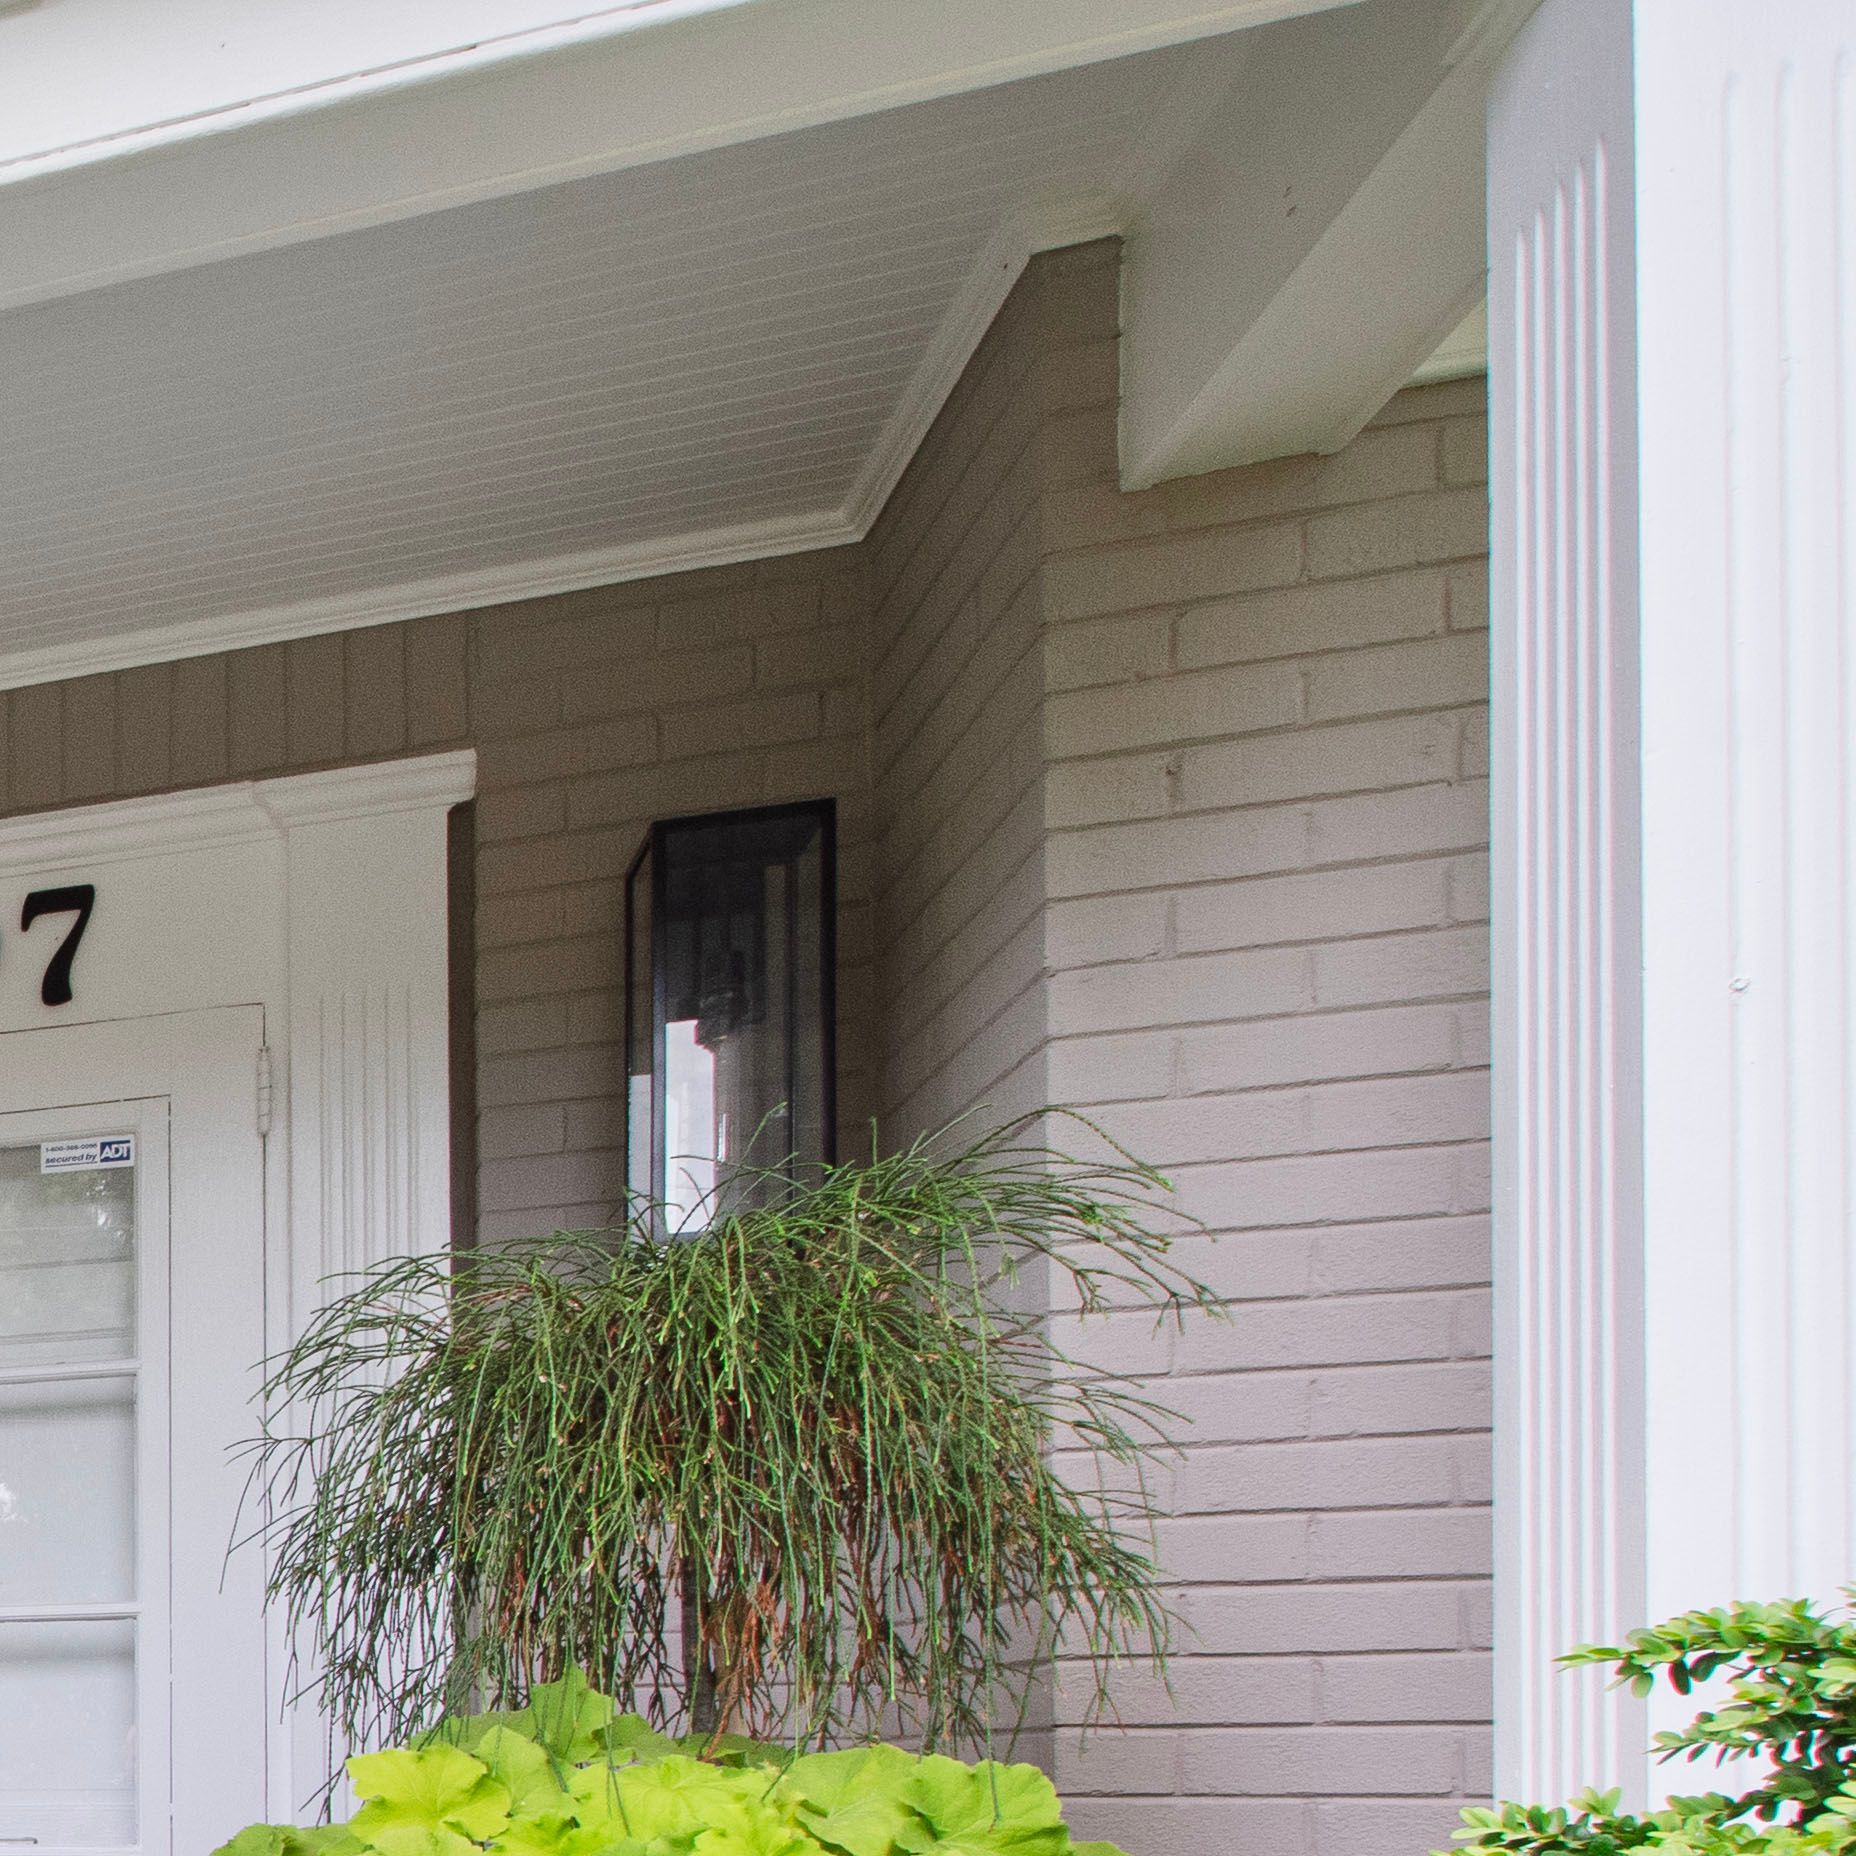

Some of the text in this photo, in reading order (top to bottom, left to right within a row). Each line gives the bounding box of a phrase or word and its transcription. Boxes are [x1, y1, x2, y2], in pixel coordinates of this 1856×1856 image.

[100, 1143, 130, 1159] ADT
[45, 1153, 97, 1164] secured by
